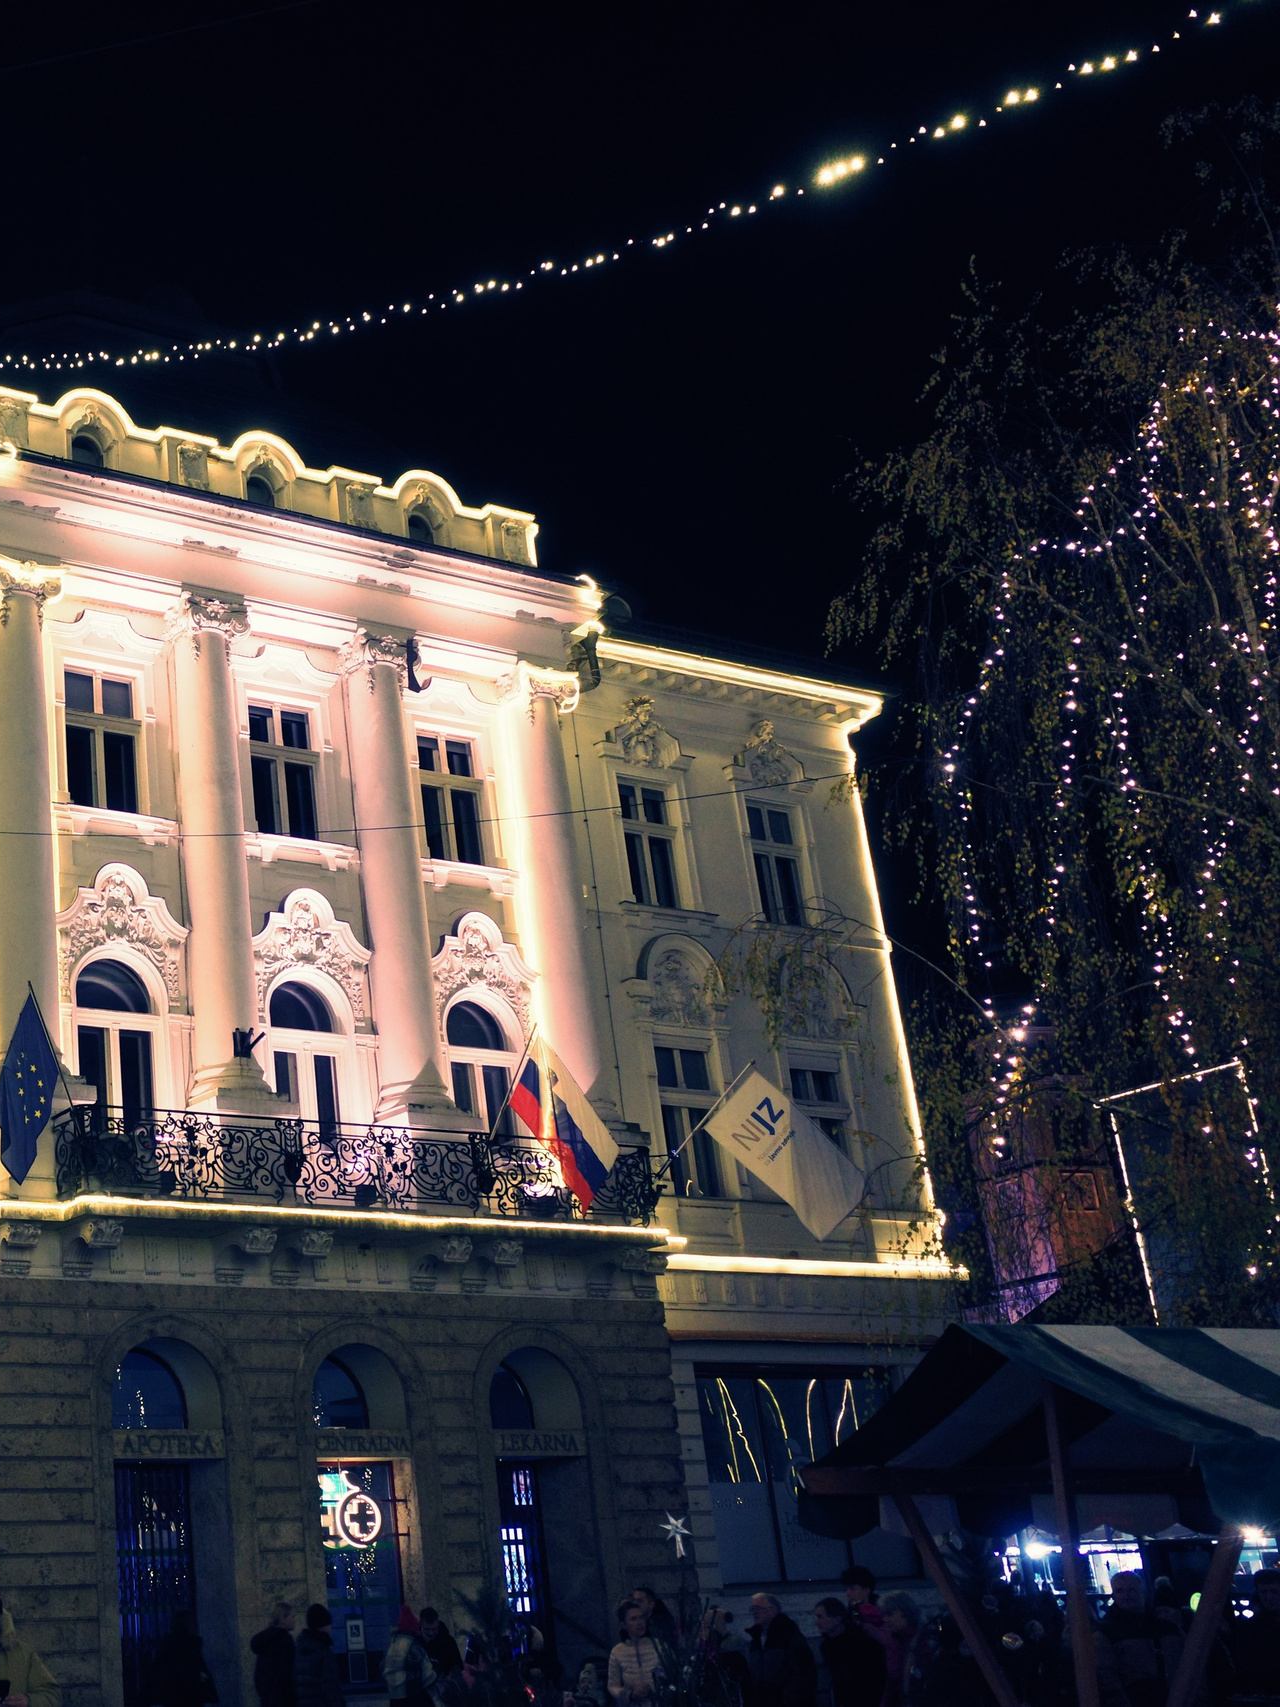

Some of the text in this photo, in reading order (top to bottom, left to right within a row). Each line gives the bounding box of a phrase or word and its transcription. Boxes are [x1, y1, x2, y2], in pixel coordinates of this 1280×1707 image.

[731, 1096, 785, 1152] NIJZ
[767, 1145, 783, 1162] javno
[122, 1433, 217, 1454] APOTEKA
[315, 1435, 410, 1452] CENTRALNA
[499, 1433, 580, 1452] LEKARNA
